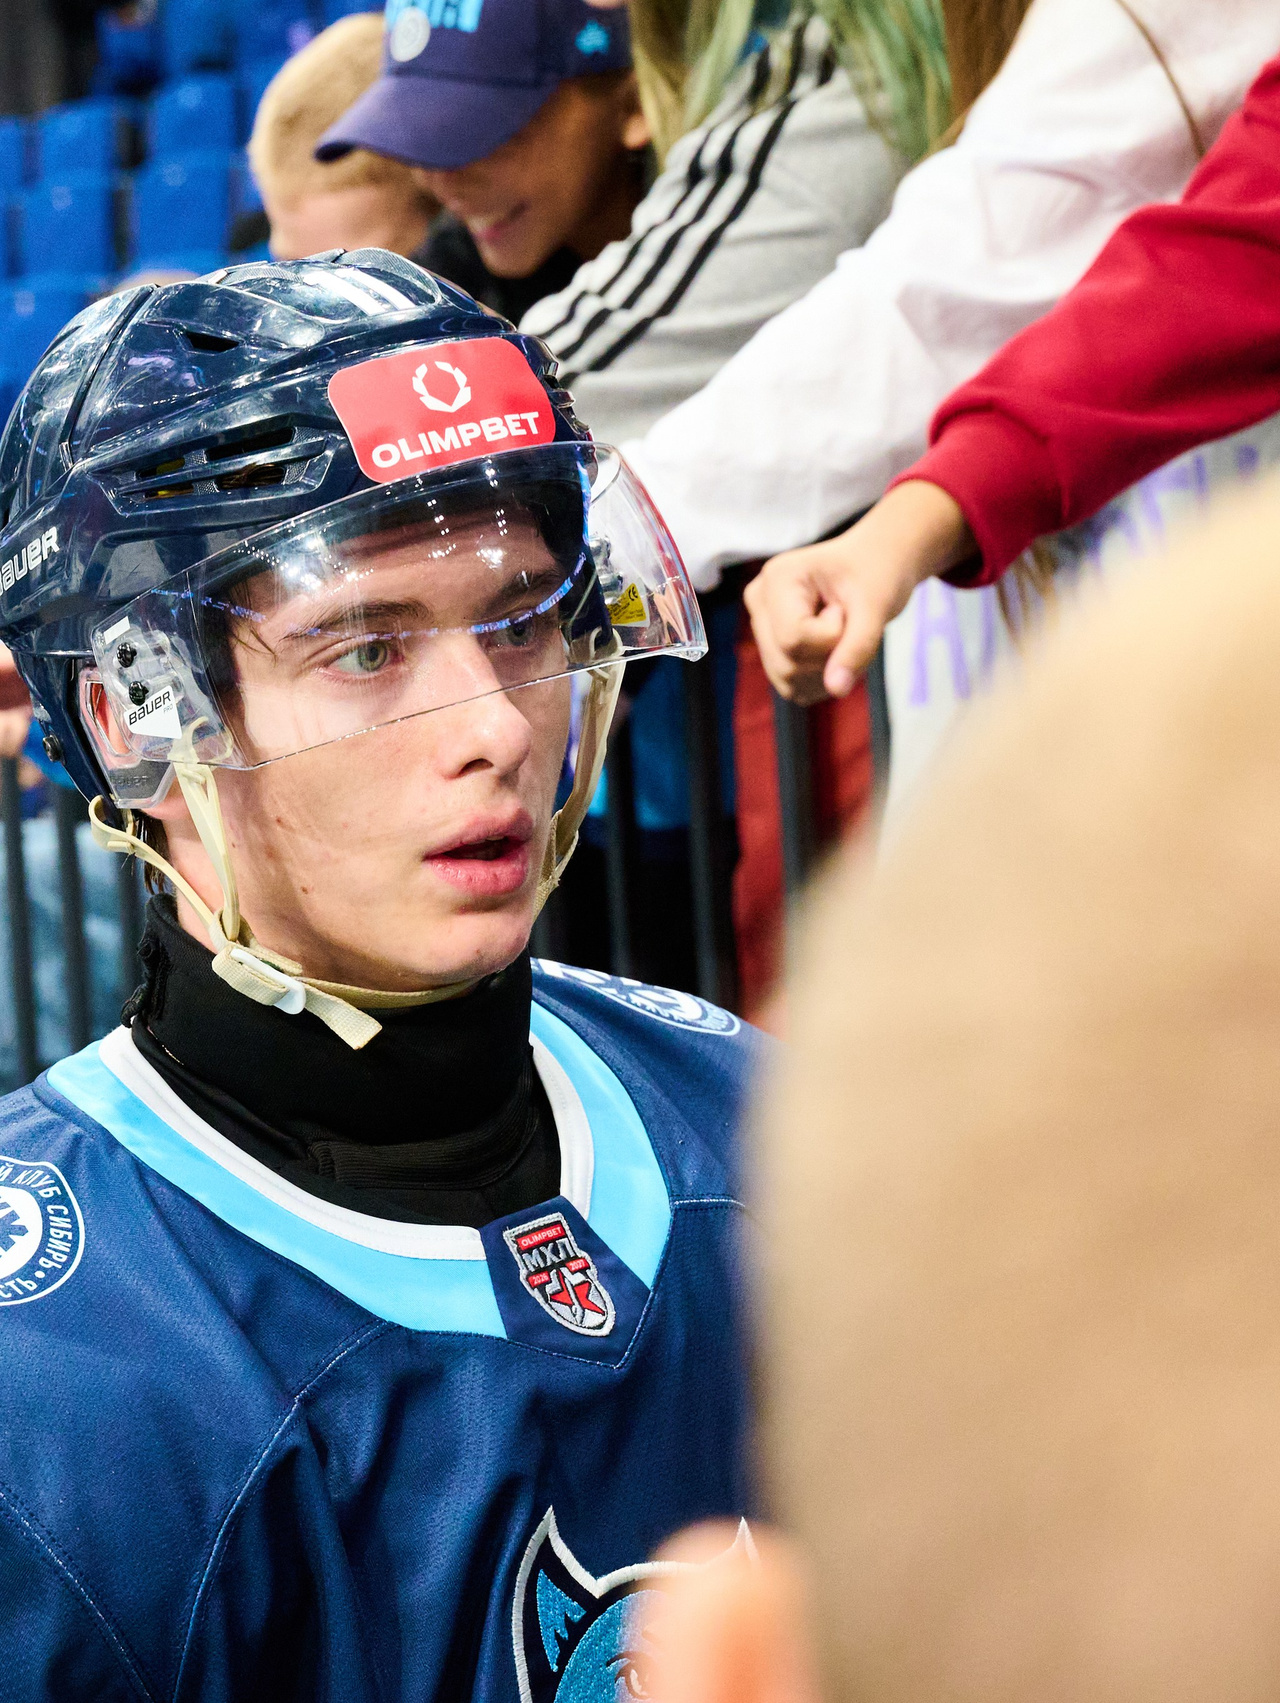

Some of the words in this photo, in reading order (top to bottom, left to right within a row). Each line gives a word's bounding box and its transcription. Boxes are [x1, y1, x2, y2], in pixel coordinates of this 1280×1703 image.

[372, 411, 539, 468] OLIMPBET
[11, 1169, 62, 1198] КЛУБ
[38, 1204, 72, 1269] СИБИРЬ
[521, 1226, 562, 1247] OLIMPBET
[522, 1238, 576, 1272] МХЛ
[569, 1259, 586, 1272] 2027
[533, 1273, 549, 1284] 2026
